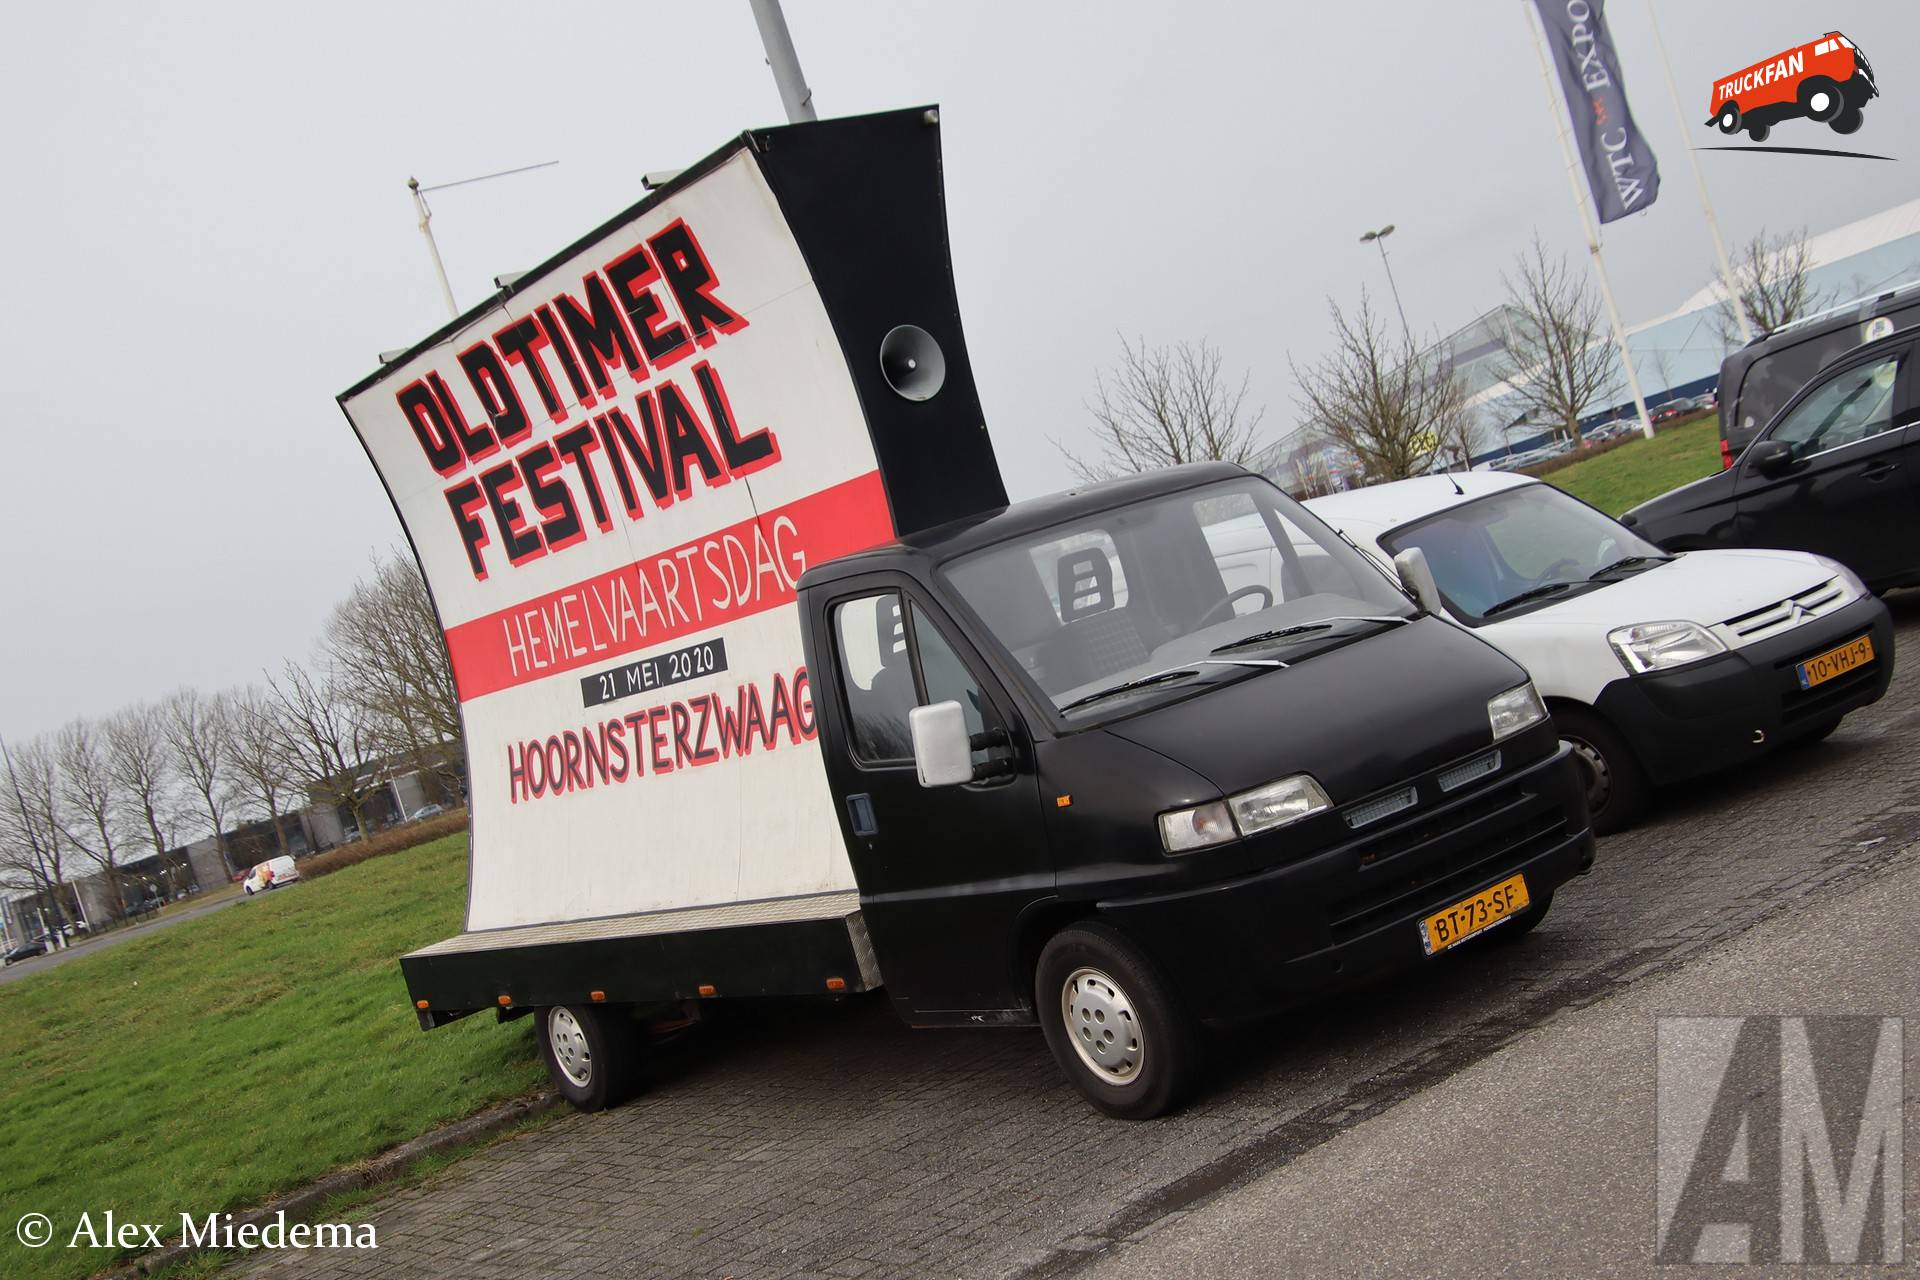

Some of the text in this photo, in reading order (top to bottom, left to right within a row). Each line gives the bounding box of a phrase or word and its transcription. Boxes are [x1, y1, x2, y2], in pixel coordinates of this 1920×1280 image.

[1567, 0, 1644, 210] WTC EXPO
[396, 217, 750, 478] OLDTIMER
[443, 359, 782, 581] FESTIVAL
[503, 515, 806, 677] HEMELVAARTSDAG
[1810, 642, 1866, 681] 10-VHJ-9
[507, 666, 819, 804] HOORNSTERZWAAG
[599, 645, 714, 700] 21 MEI 2020
[1435, 884, 1514, 943] BT-73-SF
